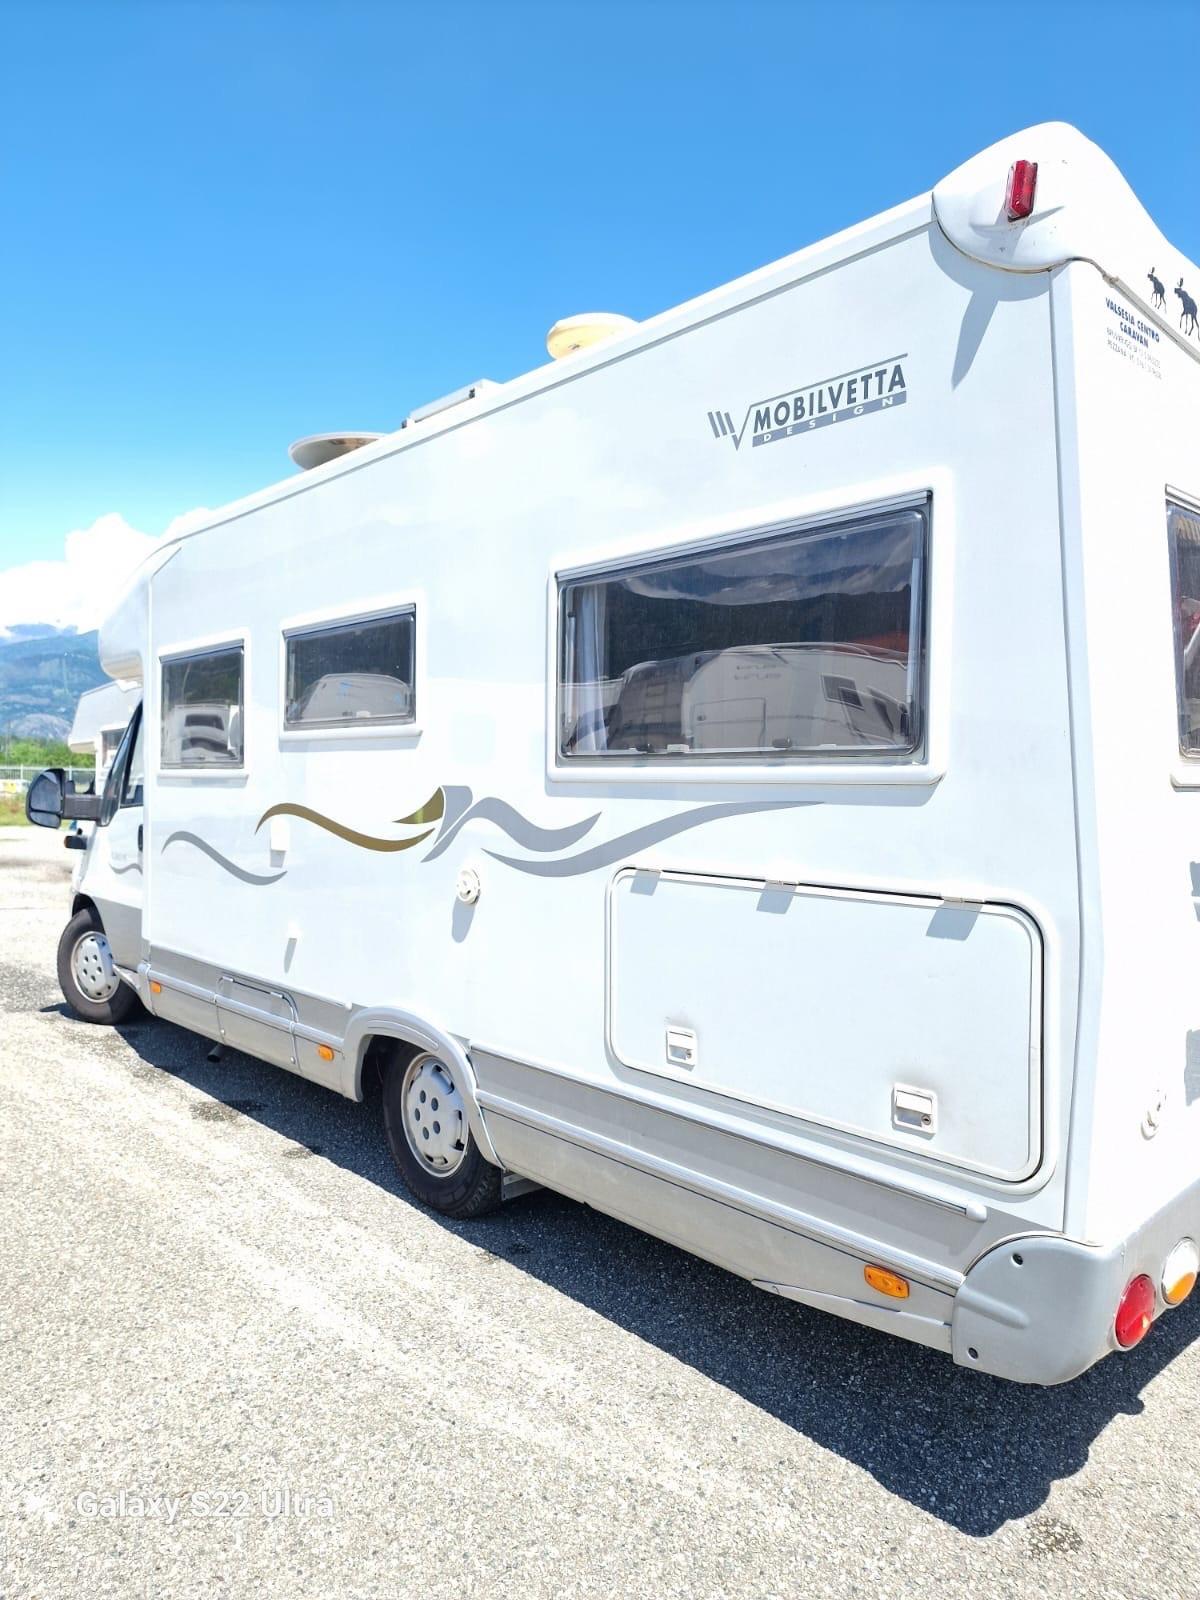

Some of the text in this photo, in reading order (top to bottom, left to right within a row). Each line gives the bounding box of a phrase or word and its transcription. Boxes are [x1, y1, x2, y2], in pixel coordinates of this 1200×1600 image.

[1105, 297, 1160, 343] VALSESIA CENTRO
[1120, 321, 1149, 348] CARAVAN
[753, 364, 906, 434] MOBILVETTA
[762, 396, 894, 443] DESIGN
